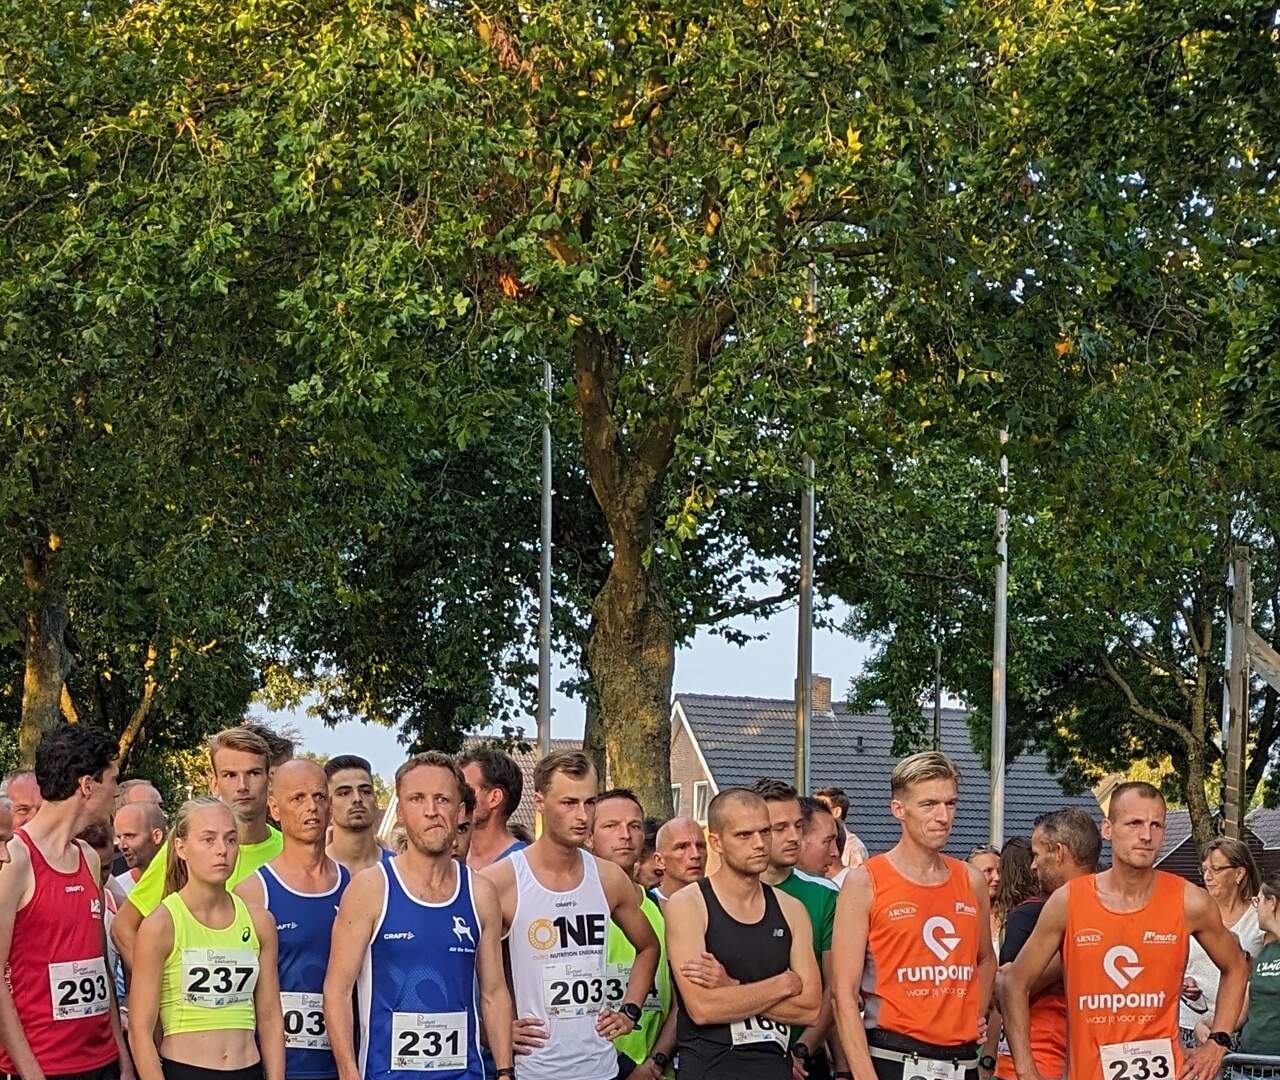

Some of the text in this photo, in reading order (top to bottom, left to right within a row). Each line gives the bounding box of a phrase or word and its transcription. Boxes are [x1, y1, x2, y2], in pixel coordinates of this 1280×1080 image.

[384, 932, 408, 940] CRAFT
[57, 975, 107, 1006] 293
[187, 966, 254, 994] 237
[1079, 990, 1166, 1013] runpoint
[398, 1030, 459, 1057] 231
